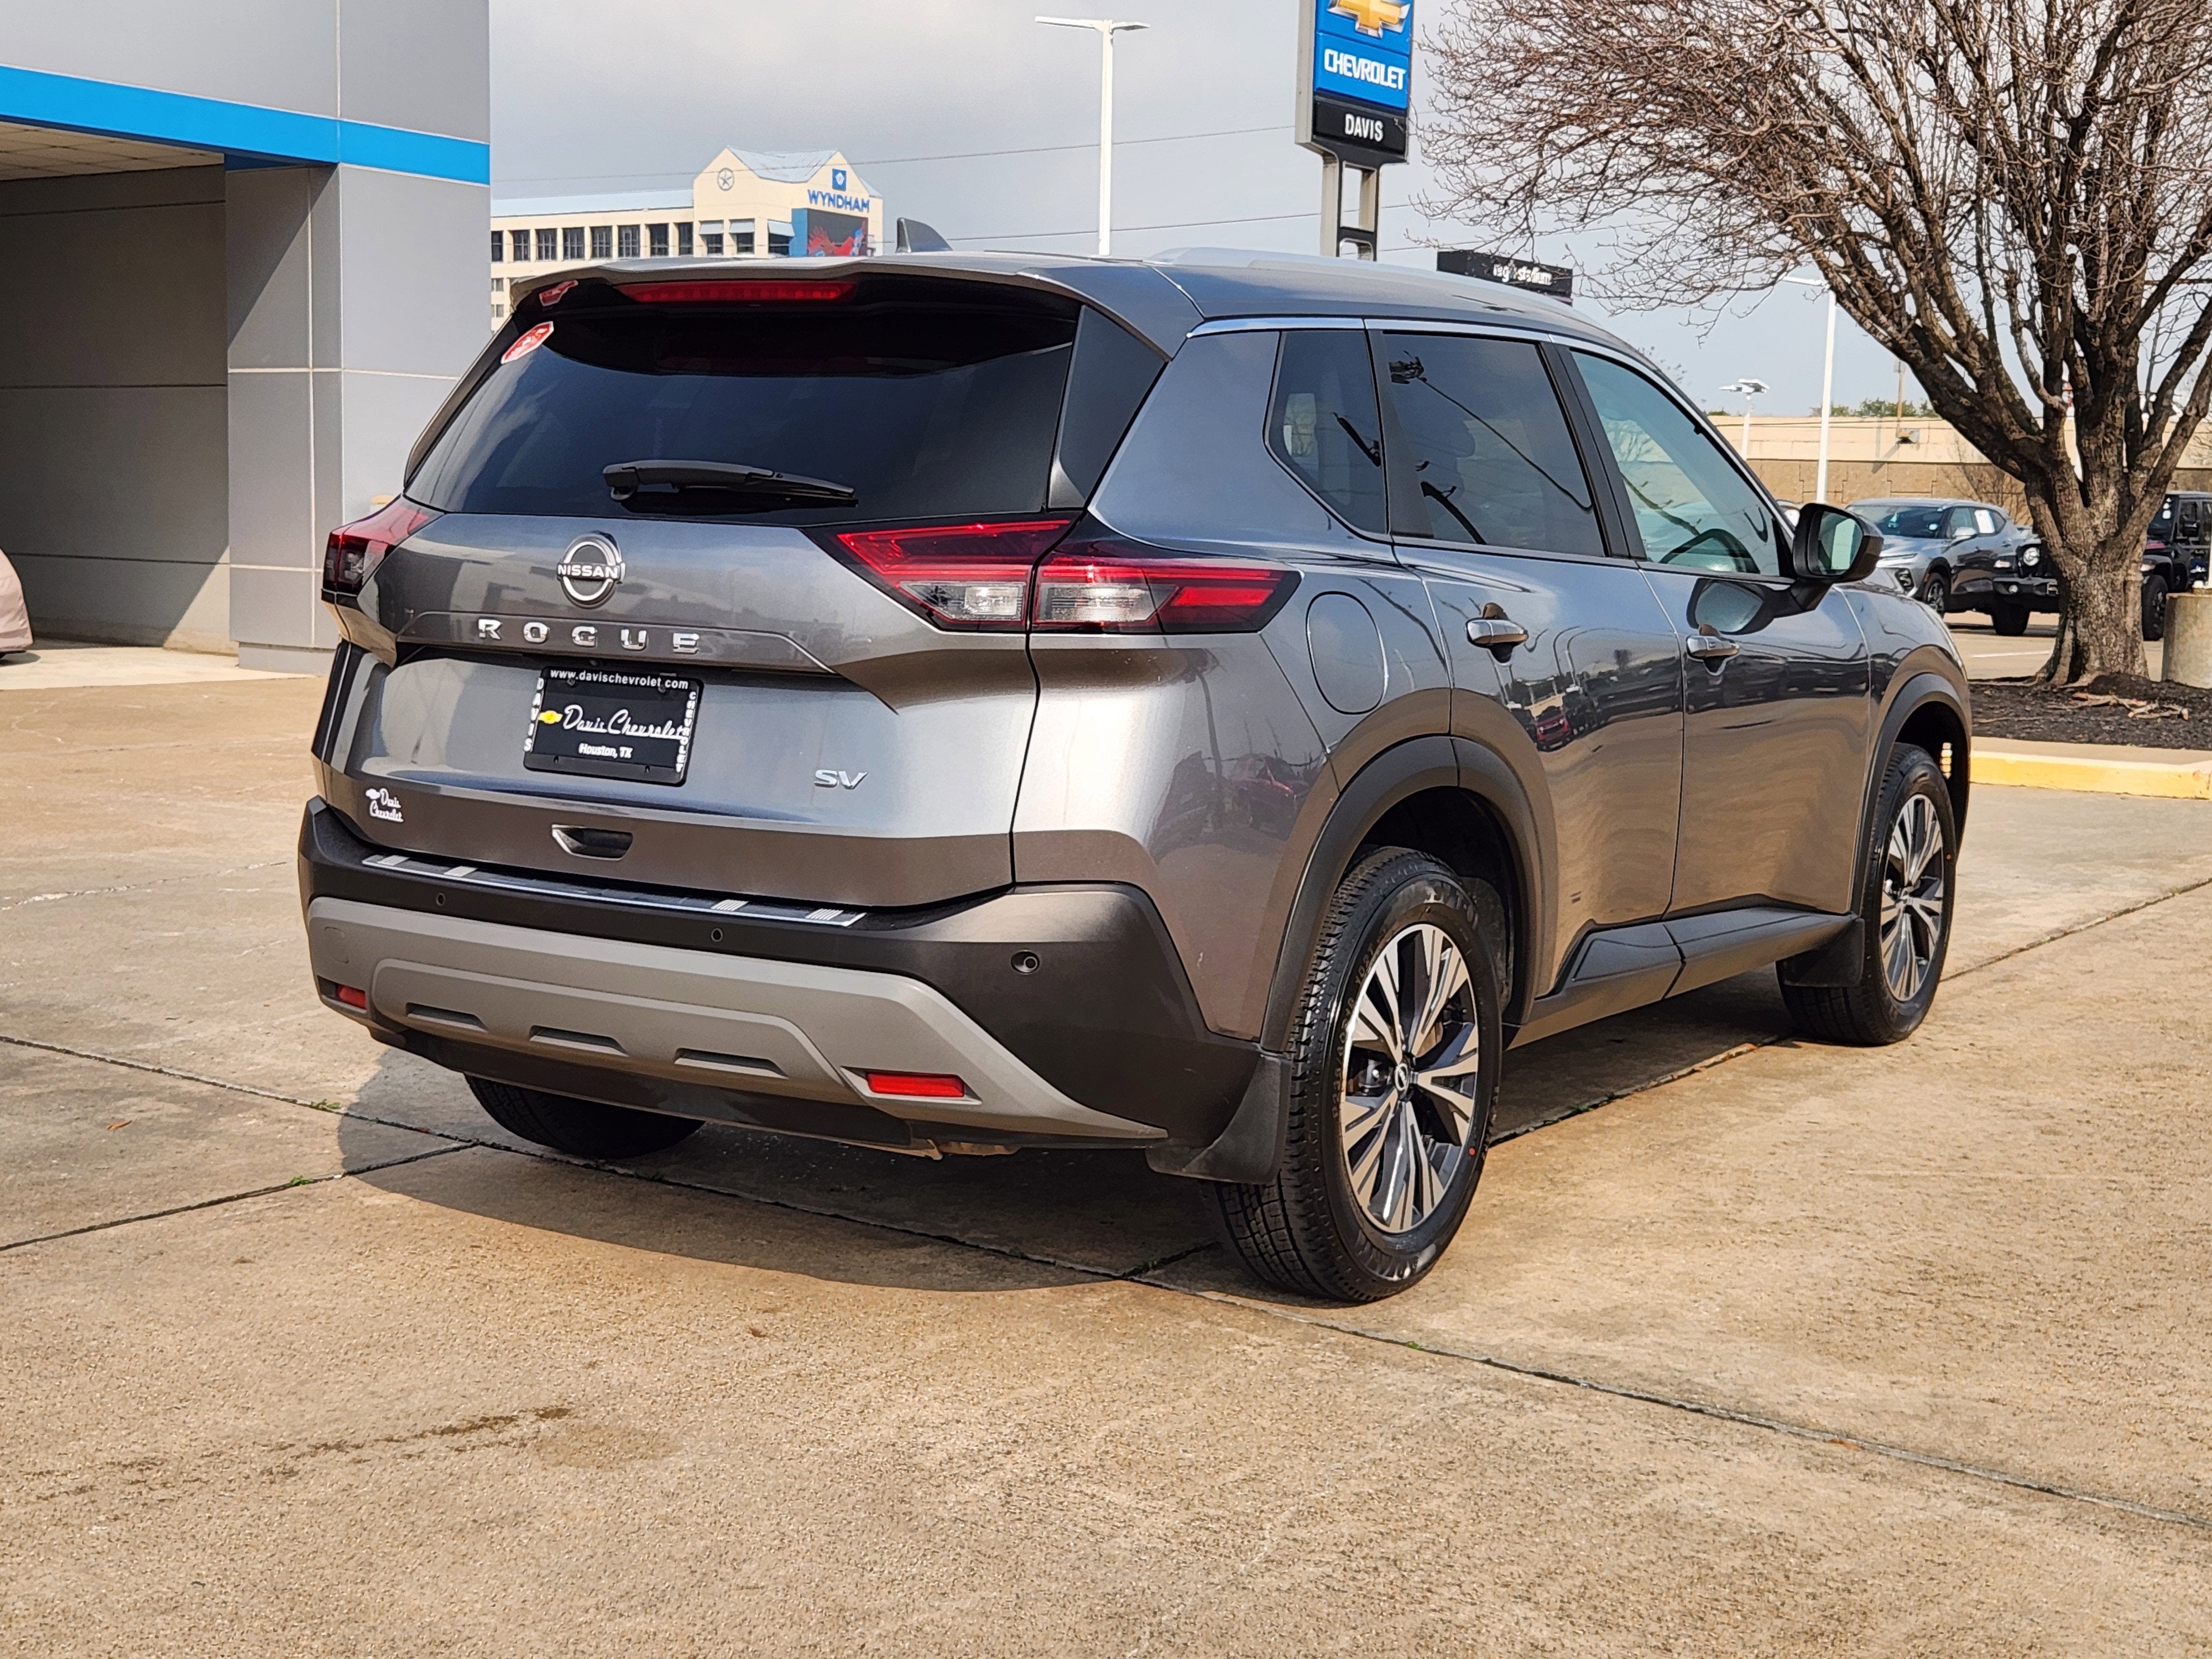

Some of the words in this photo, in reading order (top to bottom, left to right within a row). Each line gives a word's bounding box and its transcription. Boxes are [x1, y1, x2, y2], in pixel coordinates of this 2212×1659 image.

[1324, 48, 1407, 90] CHEVROLET
[1344, 113, 1384, 142] DAVIS
[807, 189, 870, 213] WYNDHAM
[557, 564, 618, 578] NISSAN
[478, 618, 700, 655] ROGUE
[550, 669, 688, 690] www.davischevroletcom
[524, 678, 544, 752] DAVIS
[563, 704, 608, 729] Davis
[608, 709, 684, 740] Chevrolet
[676, 691, 697, 773] CHEVROLET
[578, 743, 618, 759] Houston,
[619, 747, 633, 759] TX
[813, 769, 869, 790] SV
